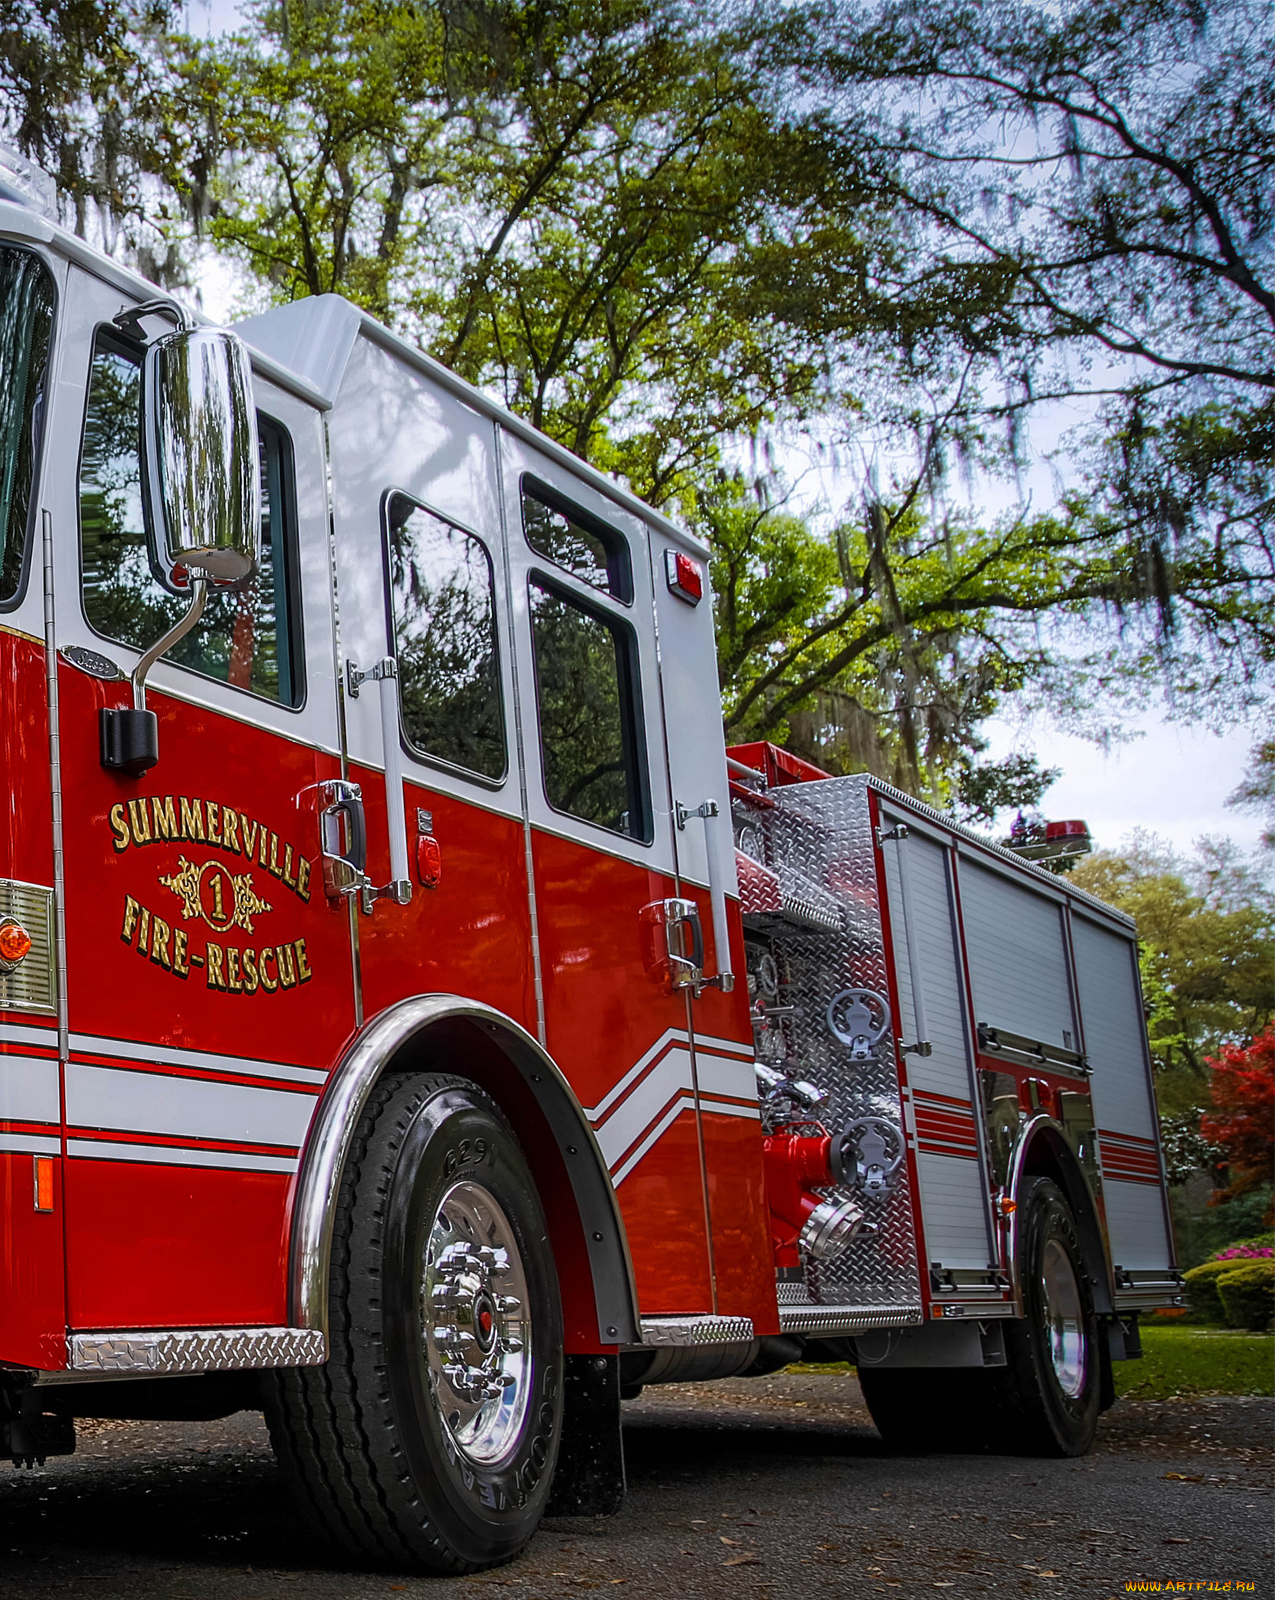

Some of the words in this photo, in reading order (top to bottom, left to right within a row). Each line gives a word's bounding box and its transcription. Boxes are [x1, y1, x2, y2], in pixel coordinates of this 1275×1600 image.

[109, 795, 311, 905] SUMMERVILLE
[208, 872, 228, 923] 1
[120, 893, 312, 996] FIRE-RESCUE
